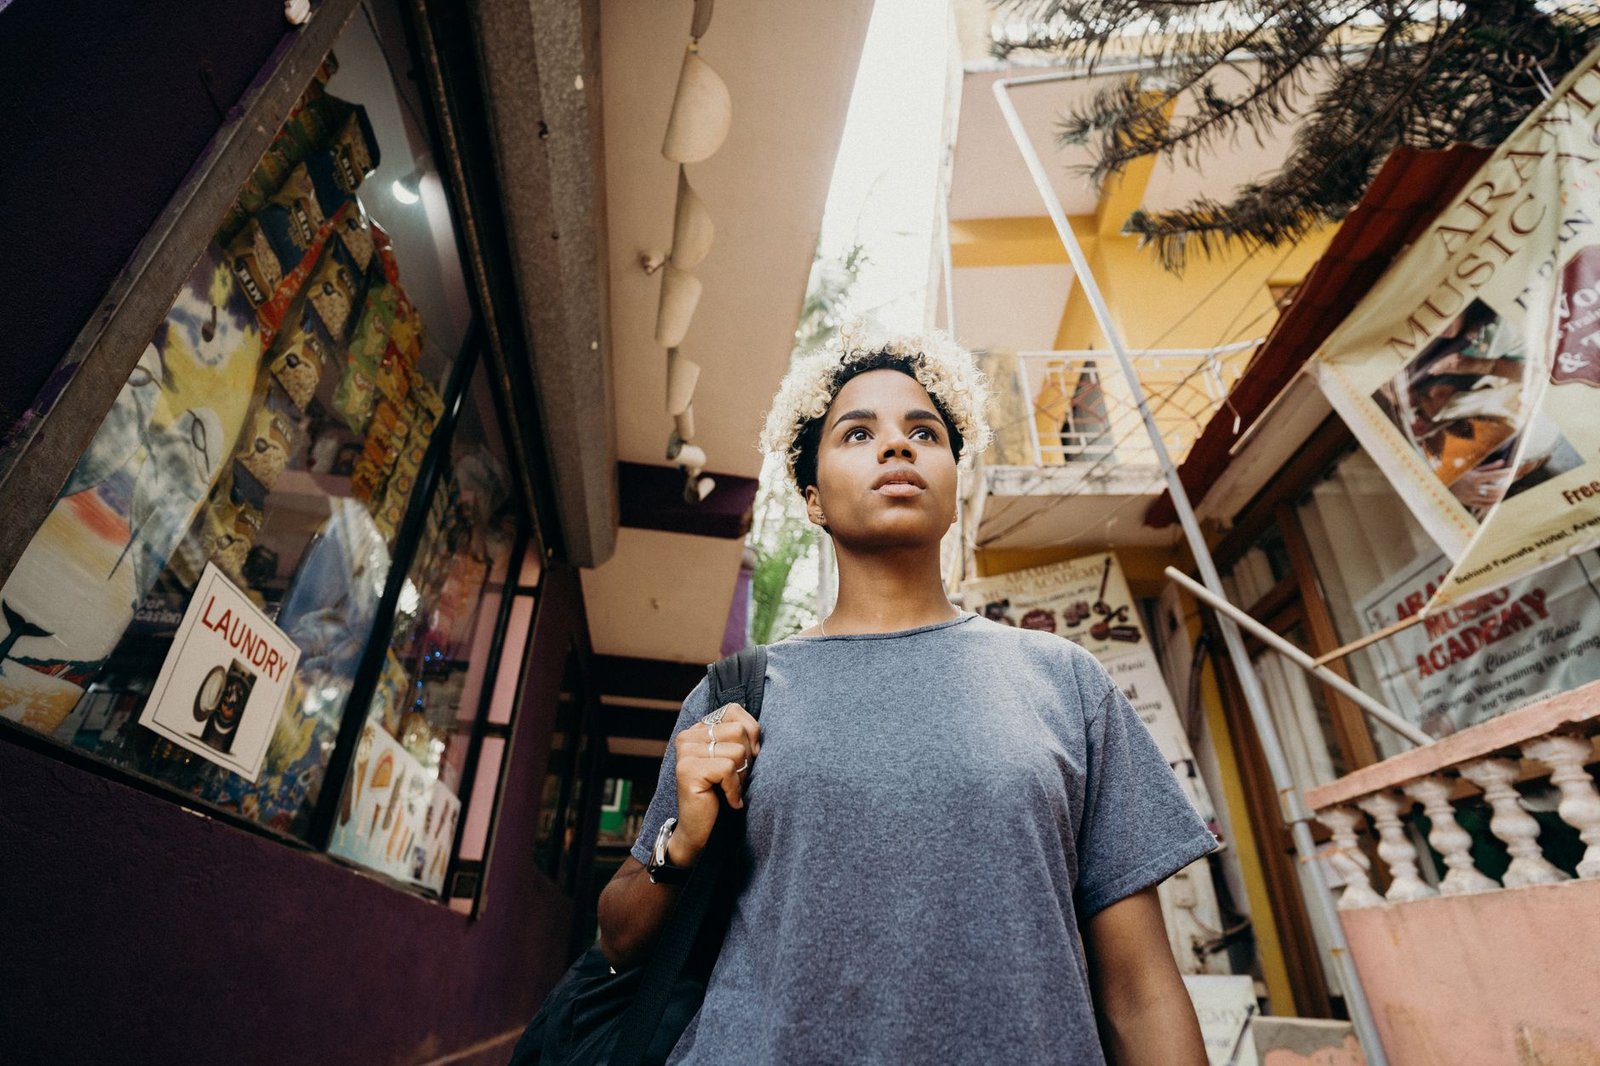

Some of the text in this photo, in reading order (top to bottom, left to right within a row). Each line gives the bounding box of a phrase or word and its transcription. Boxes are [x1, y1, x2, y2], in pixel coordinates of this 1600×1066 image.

[1384, 192, 1547, 360] MUSIC
[201, 595, 288, 684] LAUNDRY
[1416, 587, 1549, 680] ACADEMY
[1504, 661, 1545, 684] training
[1537, 620, 1582, 645] Music
